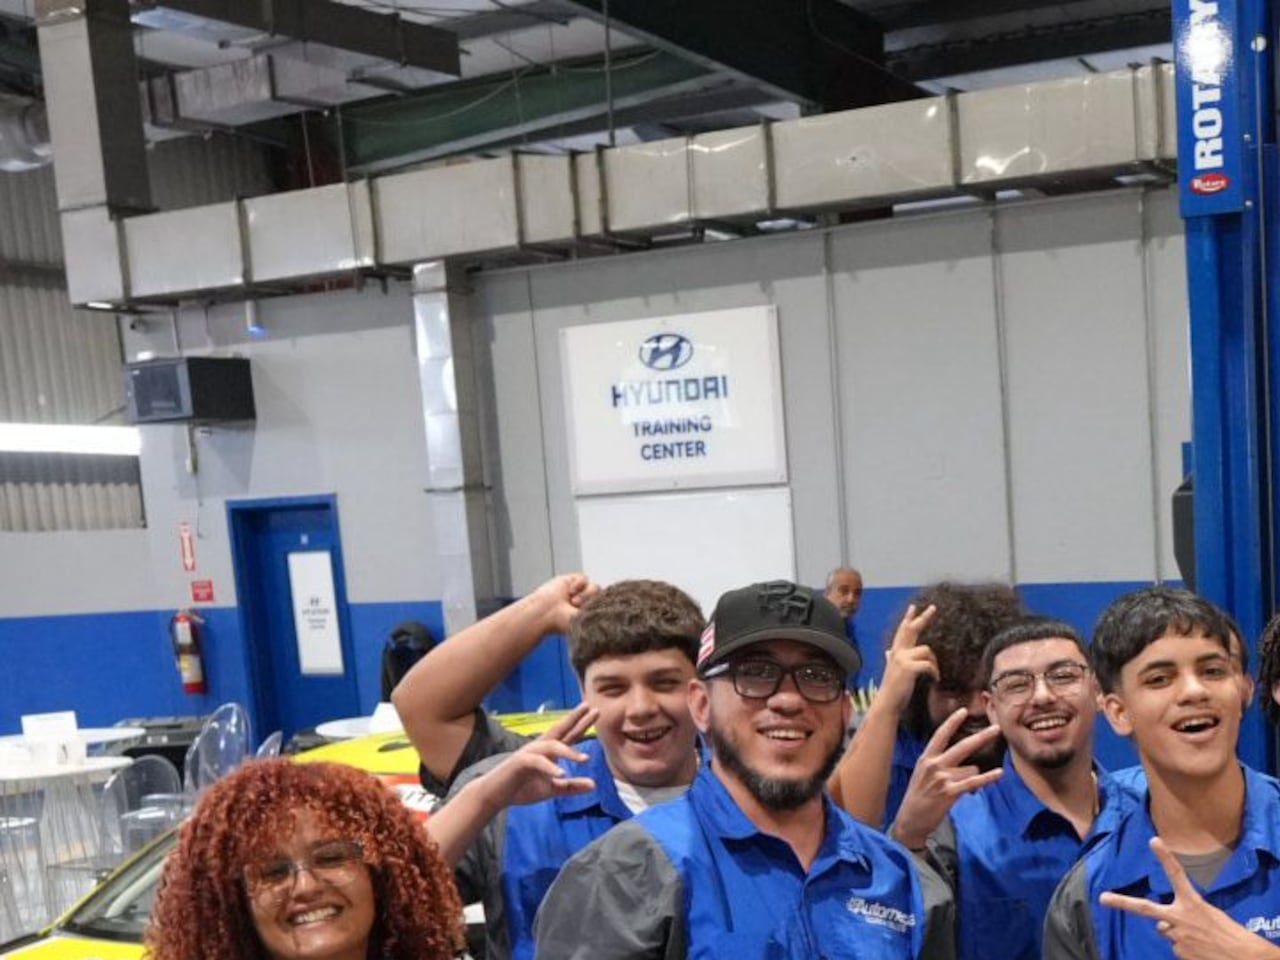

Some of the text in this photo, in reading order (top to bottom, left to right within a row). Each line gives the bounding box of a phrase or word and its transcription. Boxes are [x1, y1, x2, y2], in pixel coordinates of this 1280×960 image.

[611, 375, 727, 408] HYUNDAI
[633, 416, 712, 437] TRAINING
[640, 441, 706, 460] CENTER
